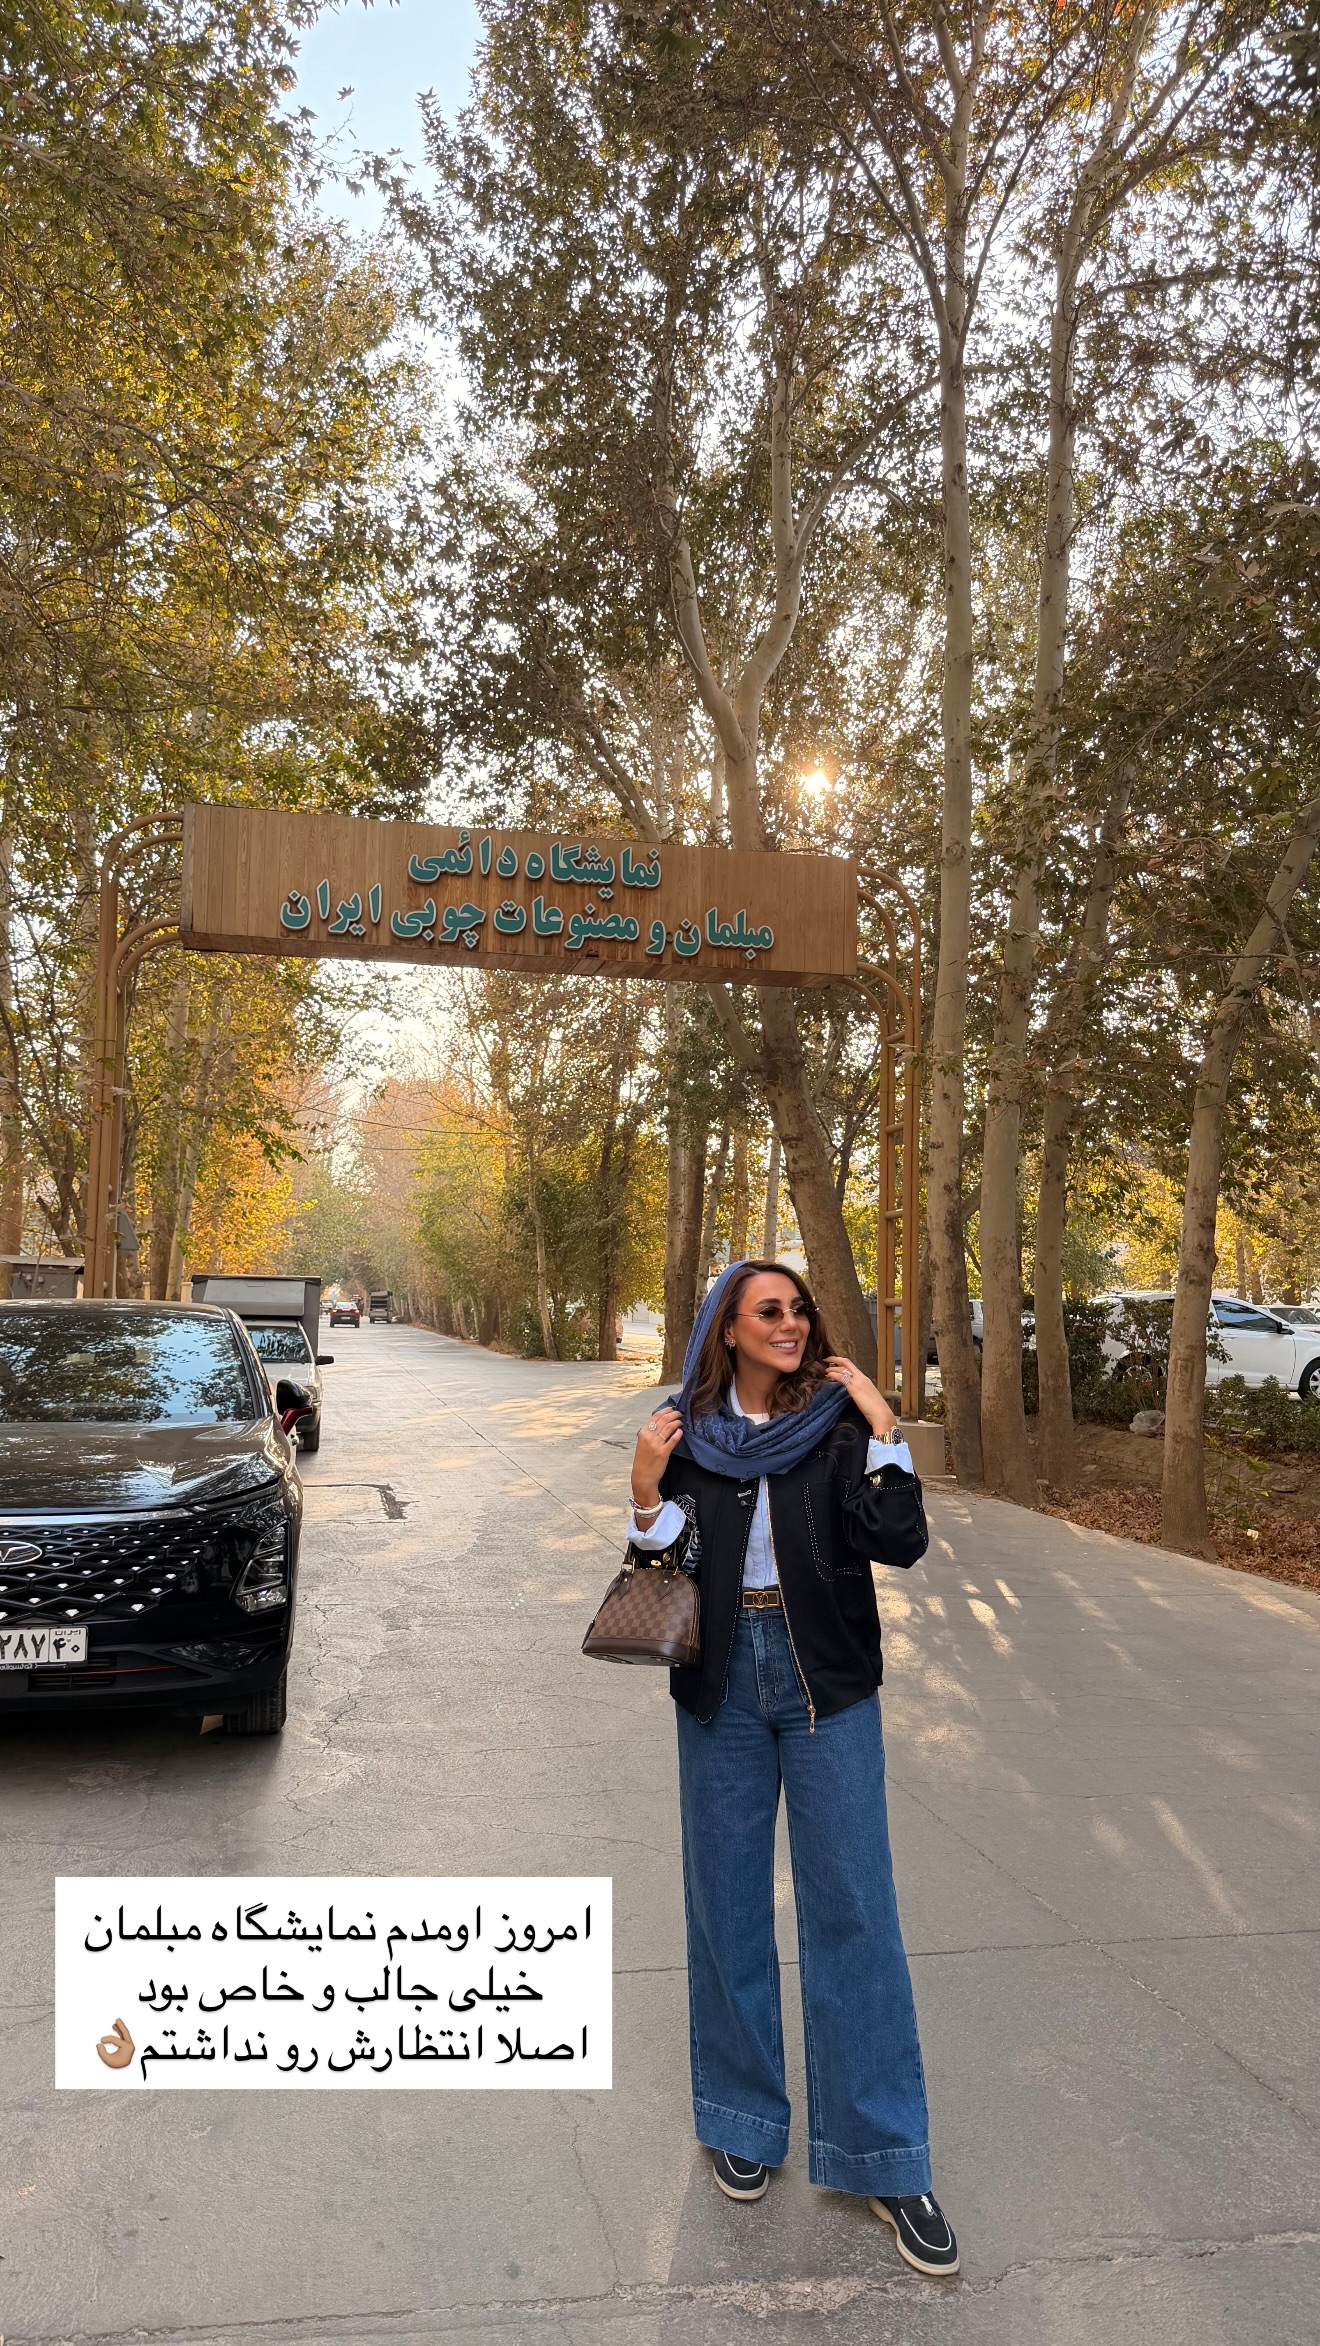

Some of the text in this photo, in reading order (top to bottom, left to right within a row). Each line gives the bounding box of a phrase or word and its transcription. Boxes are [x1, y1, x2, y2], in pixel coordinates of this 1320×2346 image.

[408, 830, 661, 899] نمایشگاه دائمی
[280, 878, 774, 960] مبلمان و مصنوعات چوبی ایران
[52, 1637, 81, 1660] ۴۰
